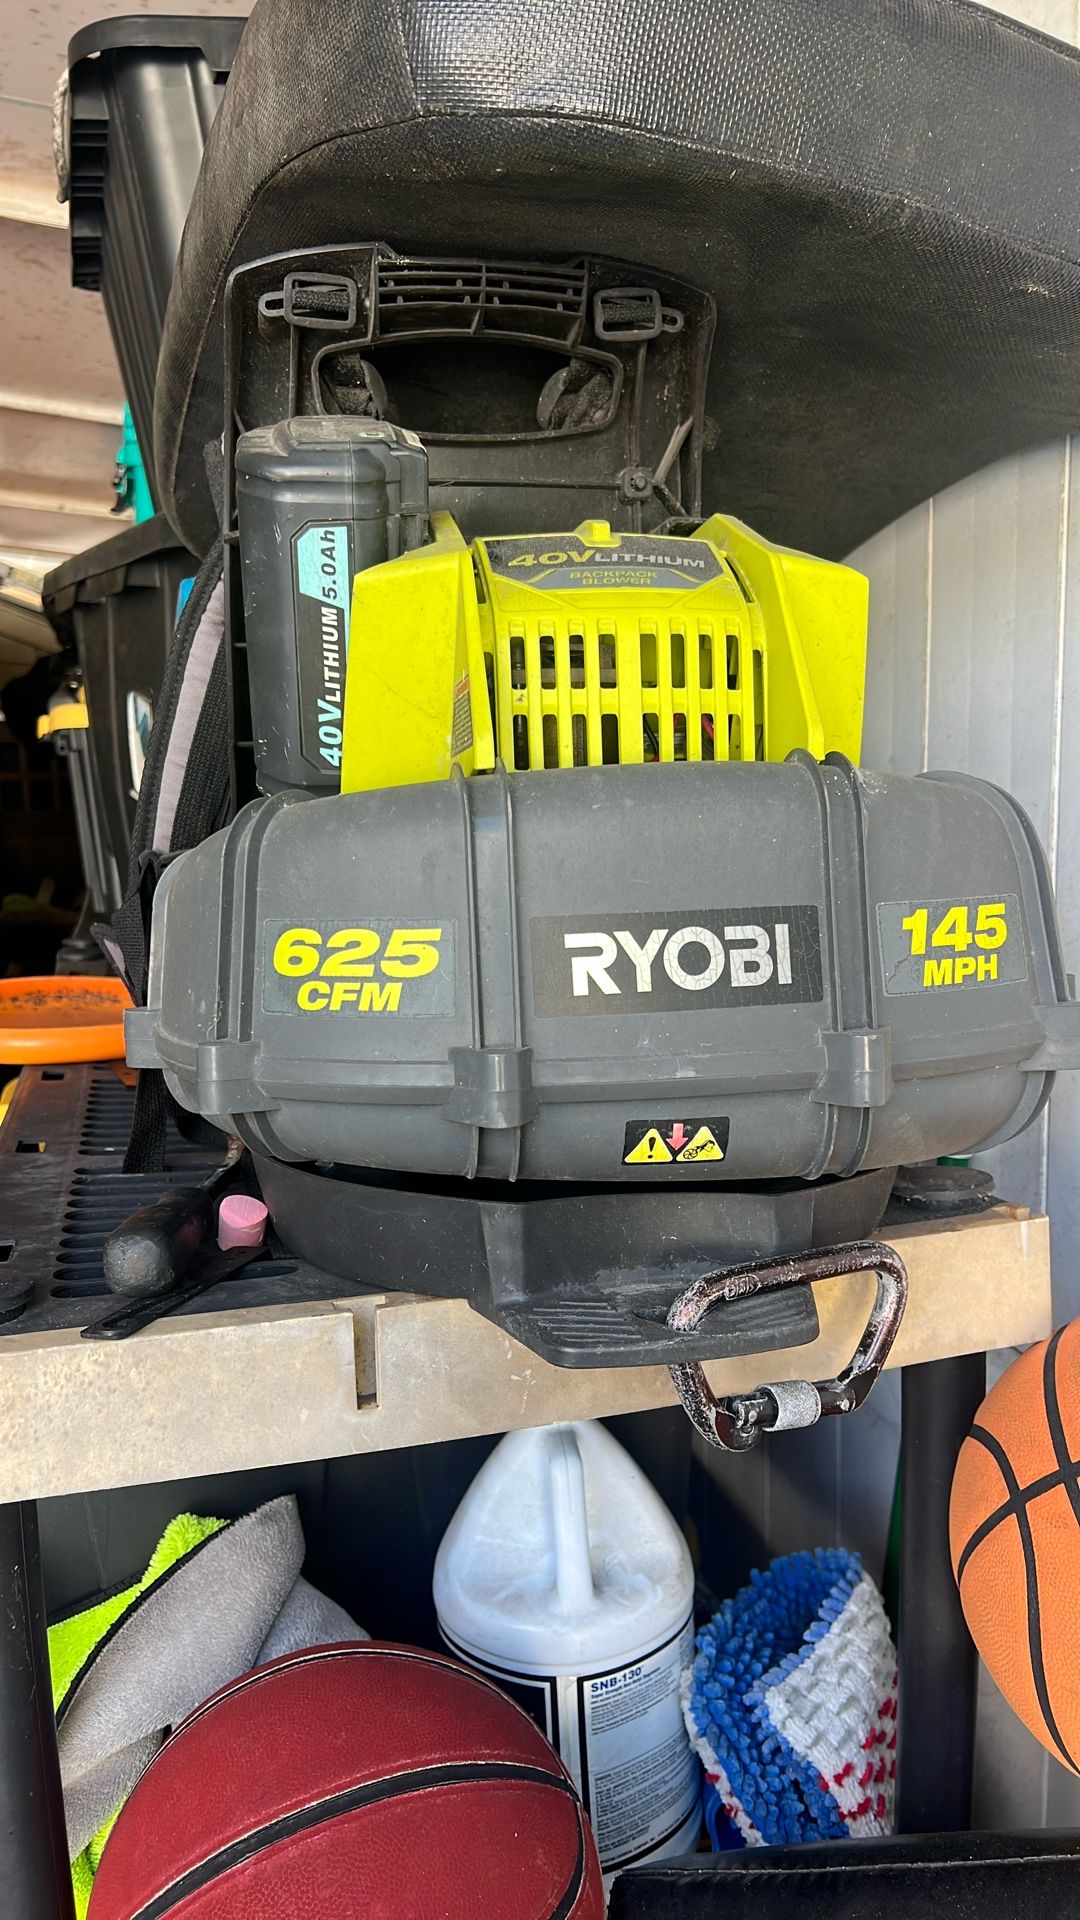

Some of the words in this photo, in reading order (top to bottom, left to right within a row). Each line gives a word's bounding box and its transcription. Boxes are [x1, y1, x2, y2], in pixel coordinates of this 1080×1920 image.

[320, 529, 338, 600] 5.0Ah
[569, 570, 657, 579] BACKPACK
[582, 576, 651, 585] BLOWER
[902, 903, 1008, 955] 145
[273, 928, 442, 978] 625
[563, 923, 793, 997] RYOBI
[922, 954, 999, 988] MPH
[297, 981, 403, 1011] CFM
[591, 1667, 642, 1692] SNB-130
